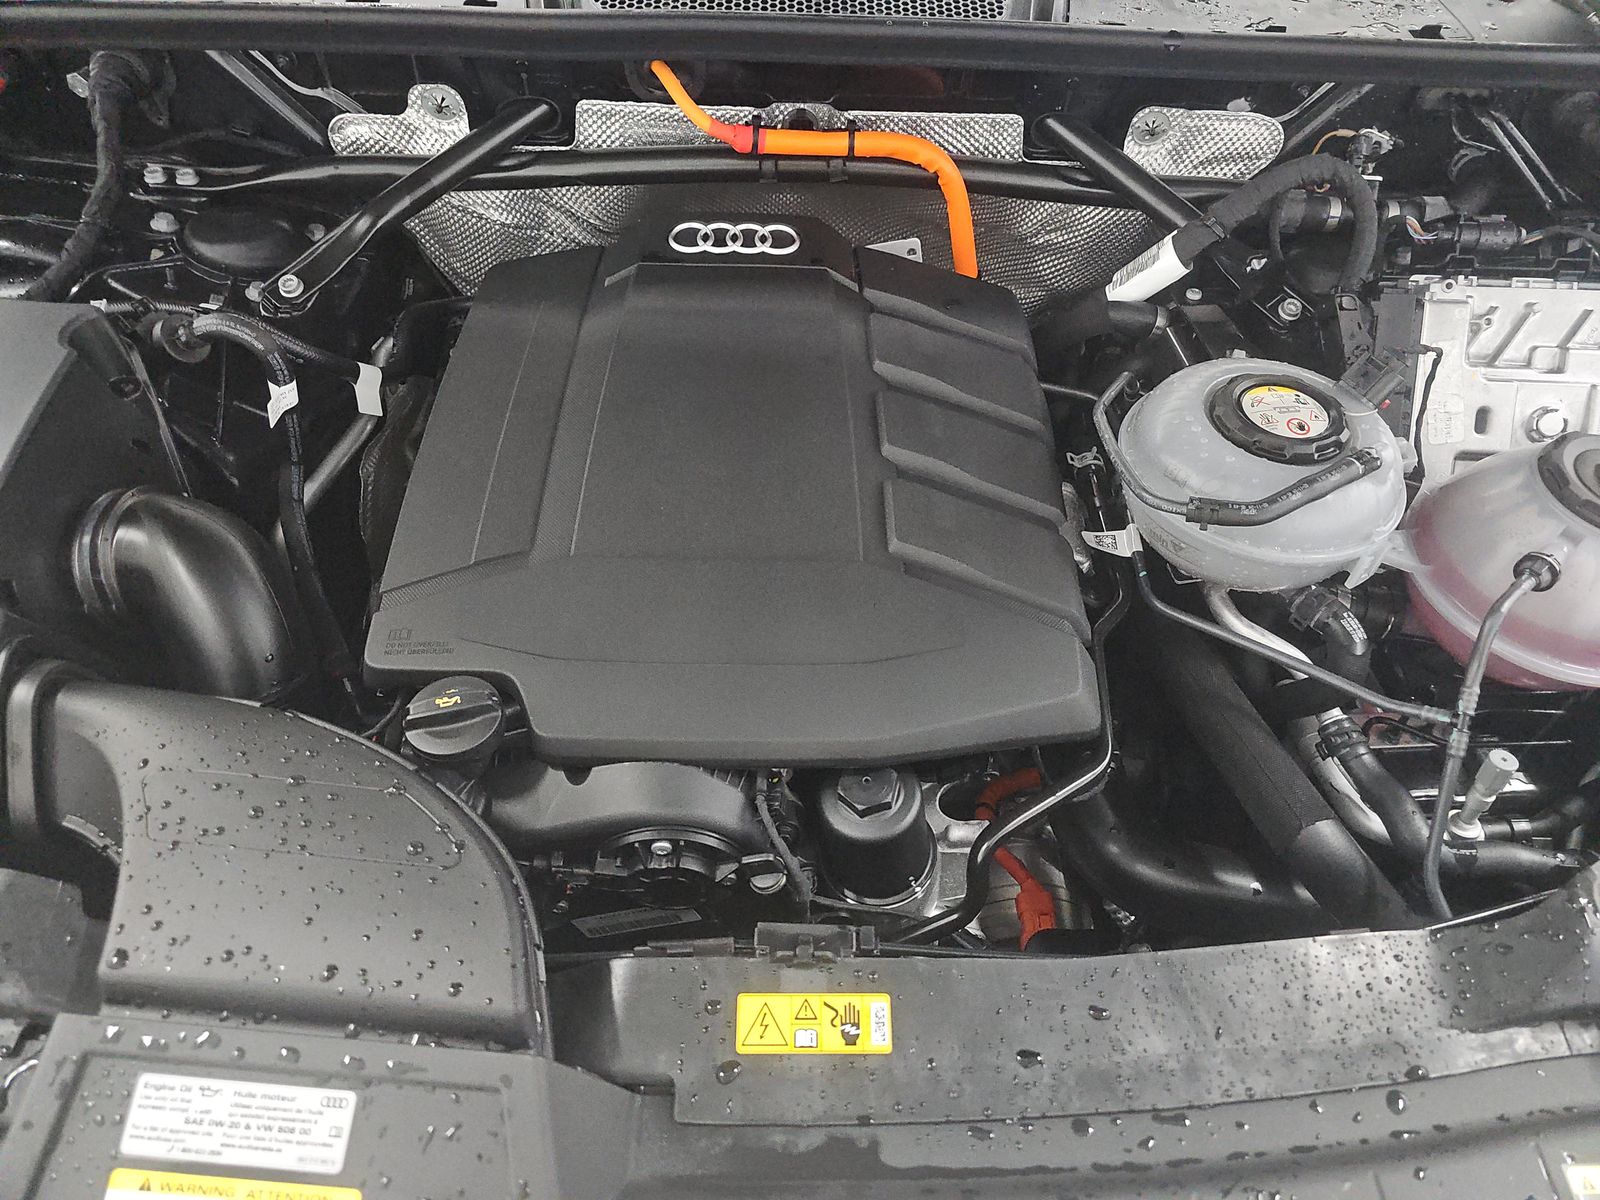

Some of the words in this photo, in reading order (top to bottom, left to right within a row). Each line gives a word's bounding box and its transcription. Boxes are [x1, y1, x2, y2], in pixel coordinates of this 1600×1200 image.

[143, 1081, 176, 1092] Engine
[179, 1084, 193, 1093] Oil
[233, 1090, 257, 1099] Huile
[260, 1093, 297, 1102] moteur
[184, 1116, 205, 1126] SAE
[256, 1123, 274, 1133] VW
[160, 1181, 235, 1198] WARNING
